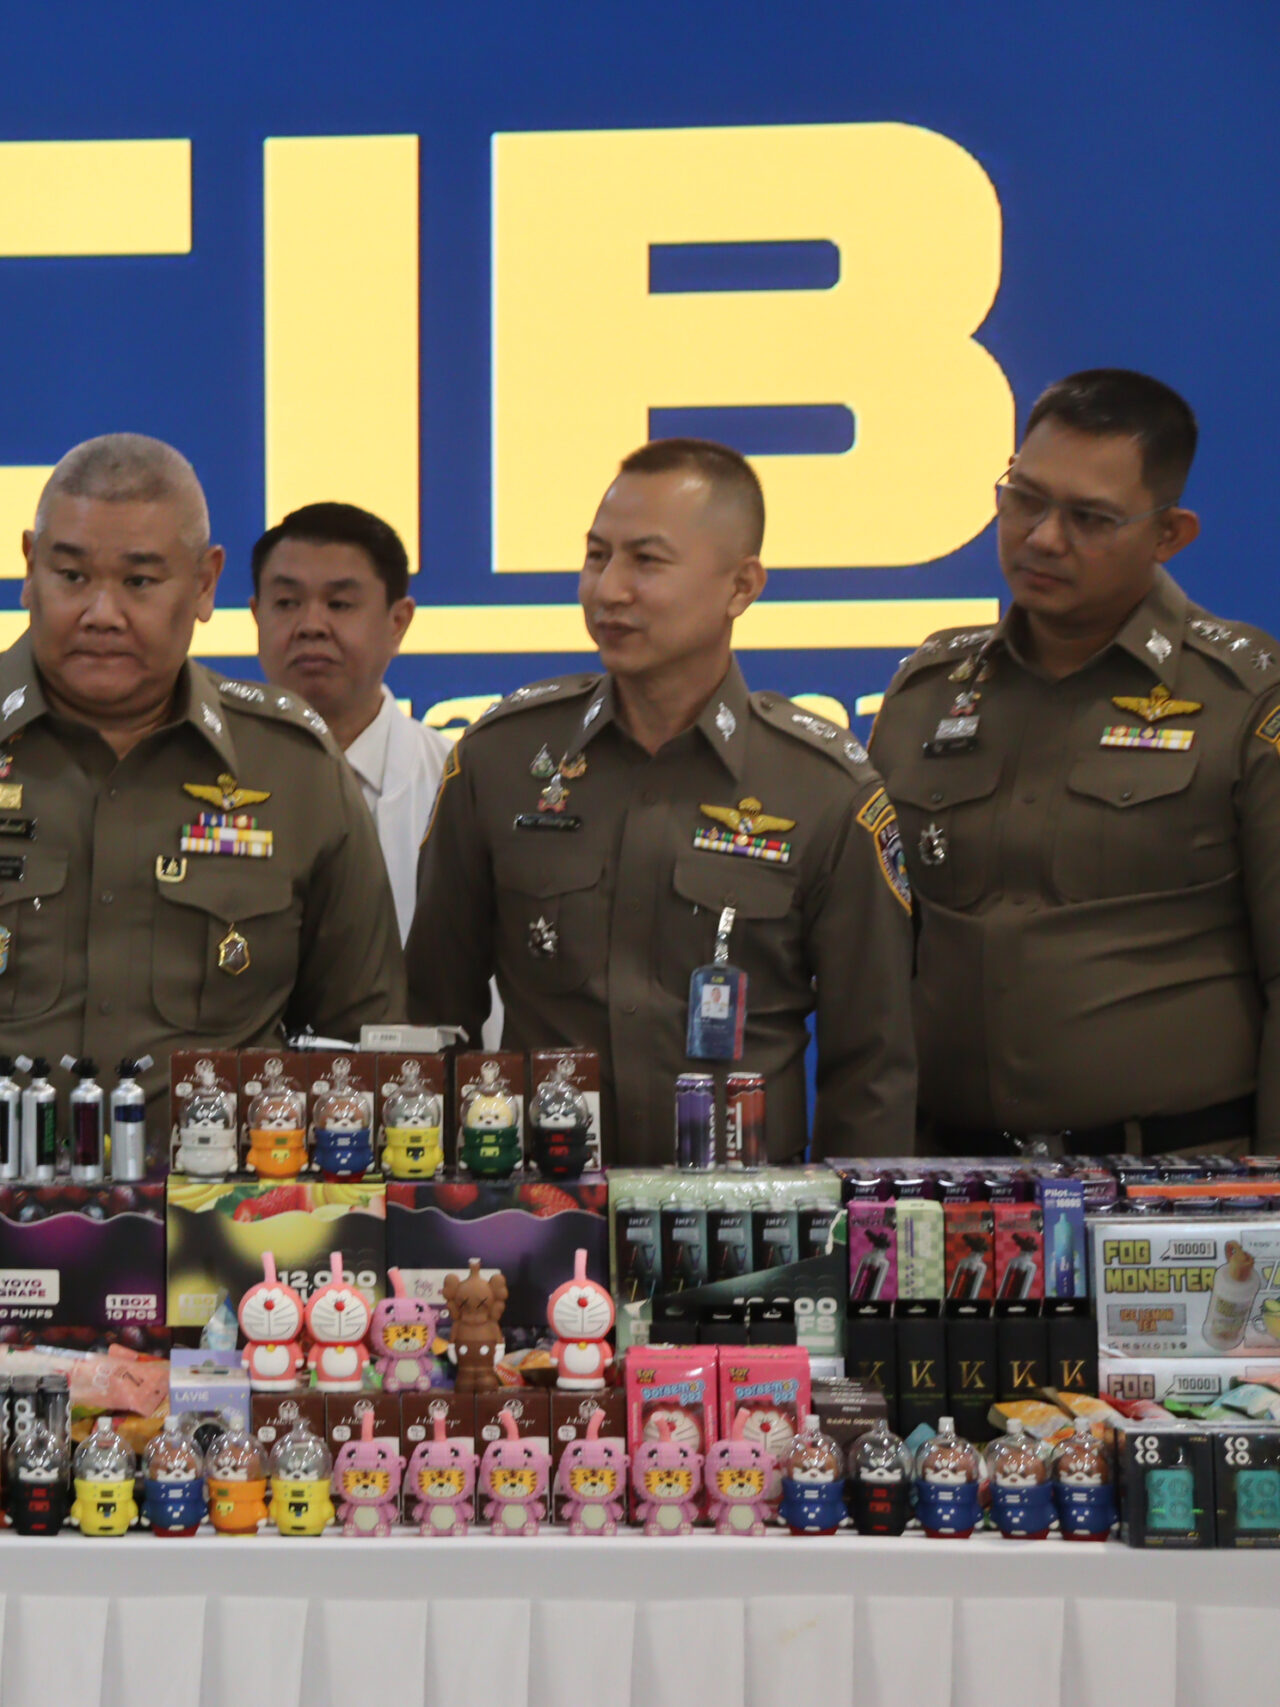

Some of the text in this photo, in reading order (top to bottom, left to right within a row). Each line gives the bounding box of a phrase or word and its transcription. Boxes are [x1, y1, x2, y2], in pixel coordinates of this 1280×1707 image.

[1103, 1240, 1151, 1265] FOG
[1, 1277, 43, 1287] YOYO
[1104, 1267, 1217, 1293] MONSTER
[119, 1297, 151, 1306] BOX
[11, 1308, 54, 1319] PUFFS
[1107, 1374, 1156, 1400] FOG
